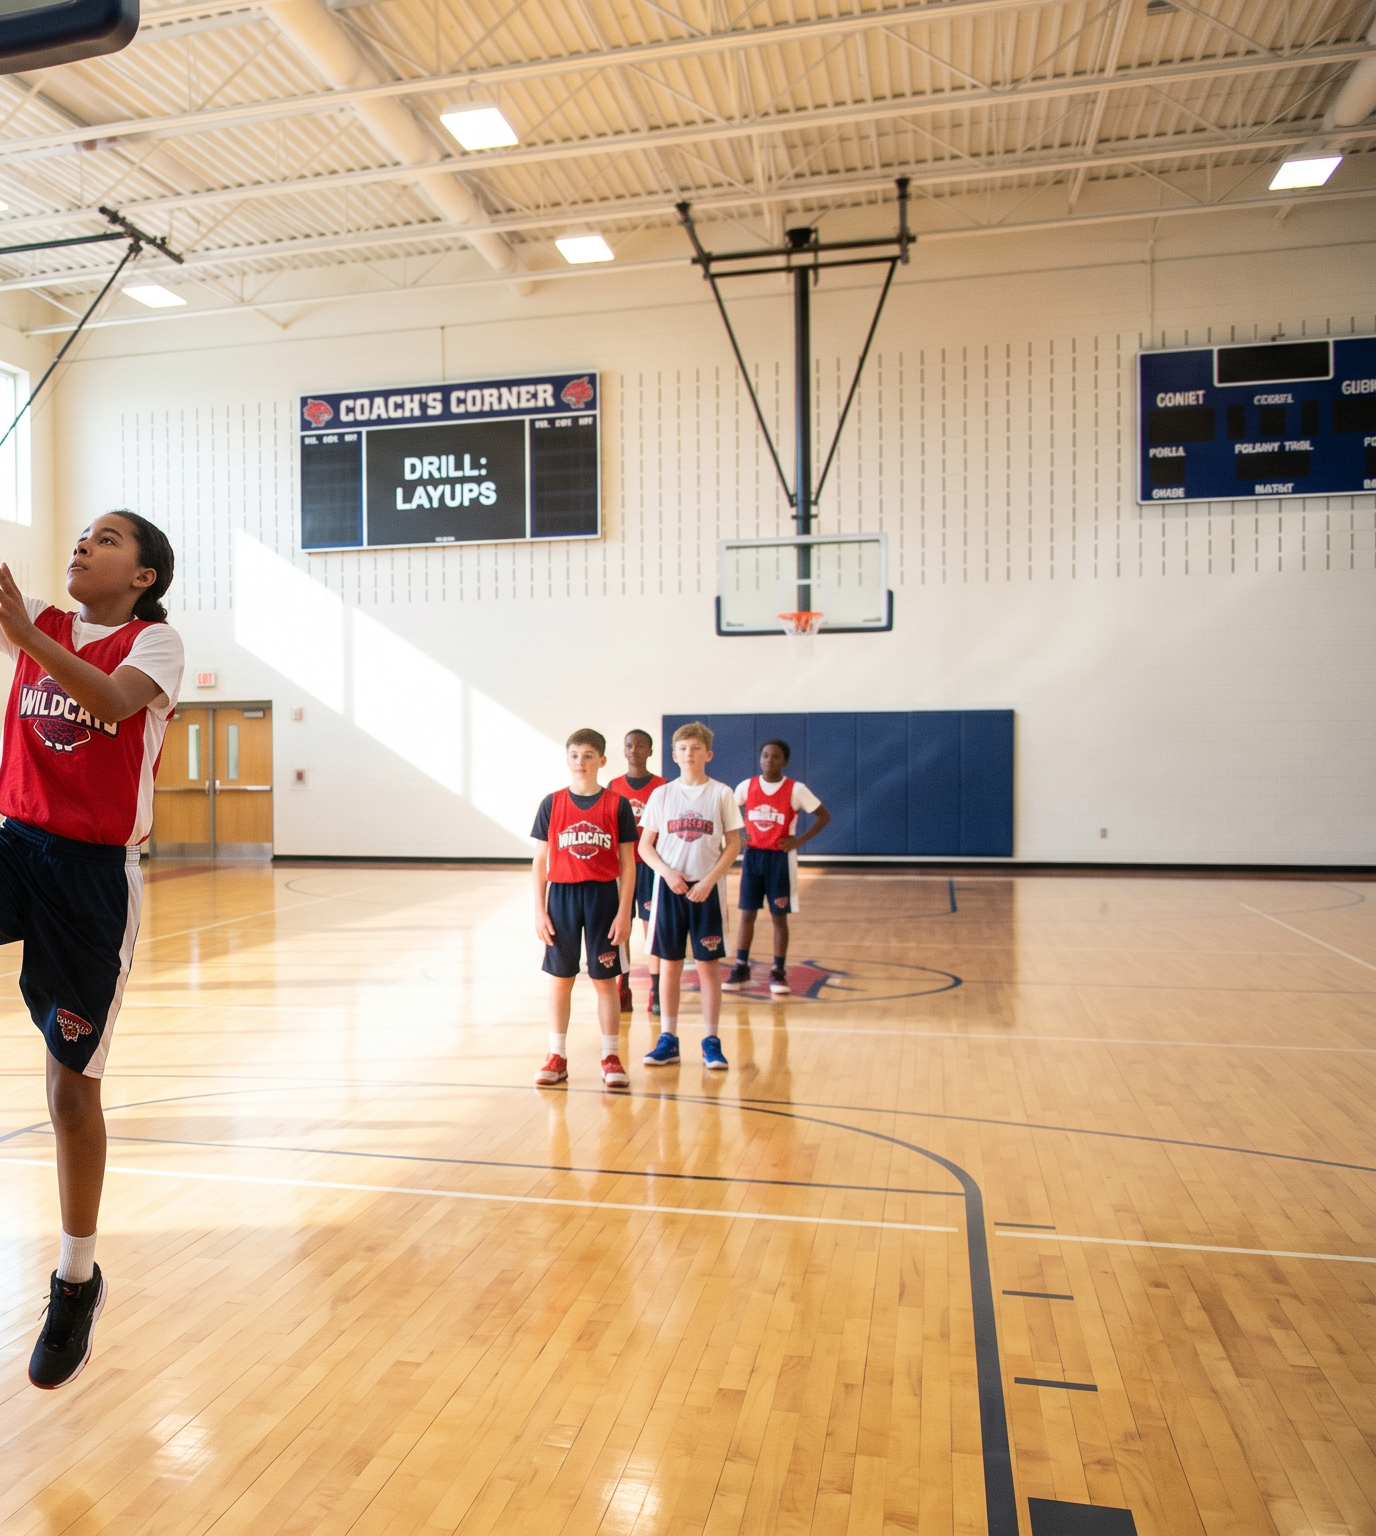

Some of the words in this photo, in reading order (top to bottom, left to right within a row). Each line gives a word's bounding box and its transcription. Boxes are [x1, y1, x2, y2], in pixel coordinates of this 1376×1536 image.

[339, 392, 443, 422] COACH'S
[449, 383, 555, 414] CORNER
[404, 453, 487, 481] DRILL:
[396, 481, 497, 510] LAYUPS
[557, 831, 612, 850] WILDCATS
